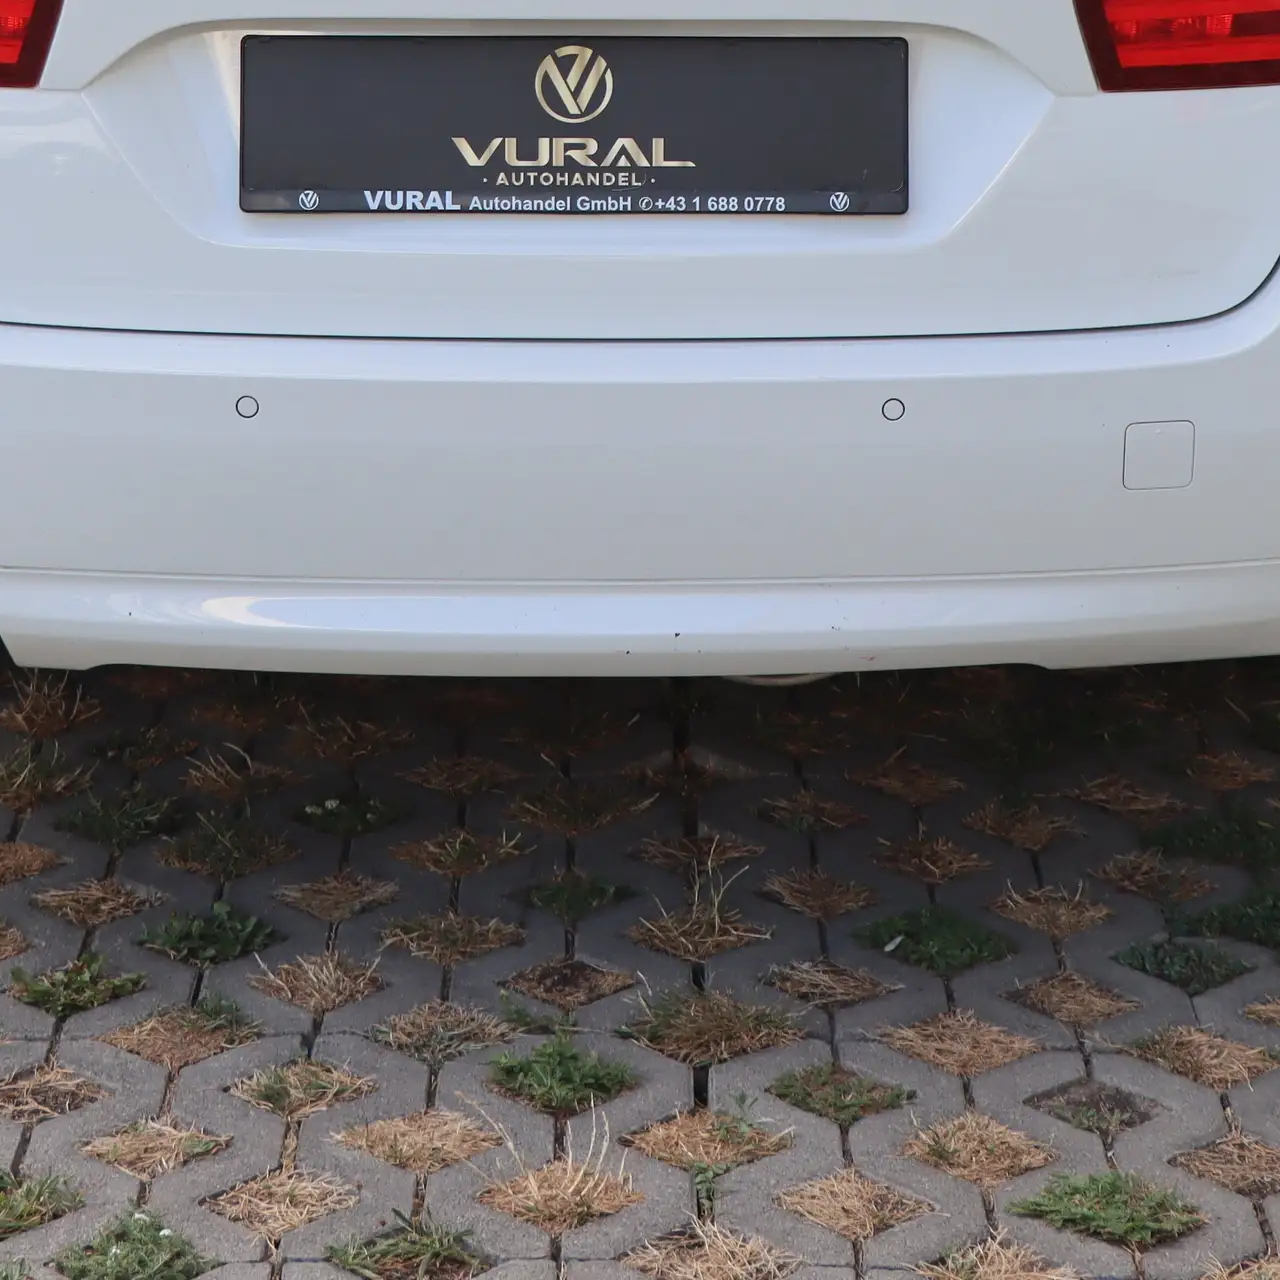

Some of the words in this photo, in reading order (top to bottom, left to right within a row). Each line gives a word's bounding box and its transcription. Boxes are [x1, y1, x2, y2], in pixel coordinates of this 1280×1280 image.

[451, 136, 697, 168] VURAL
[495, 172, 642, 186] AUTOHANDEL
[363, 190, 461, 211] VURAL
[468, 195, 571, 211] Autohandel
[576, 195, 632, 211] GmbH
[692, 196, 701, 211] 1
[707, 196, 739, 211] 688
[743, 196, 786, 211] 0778
